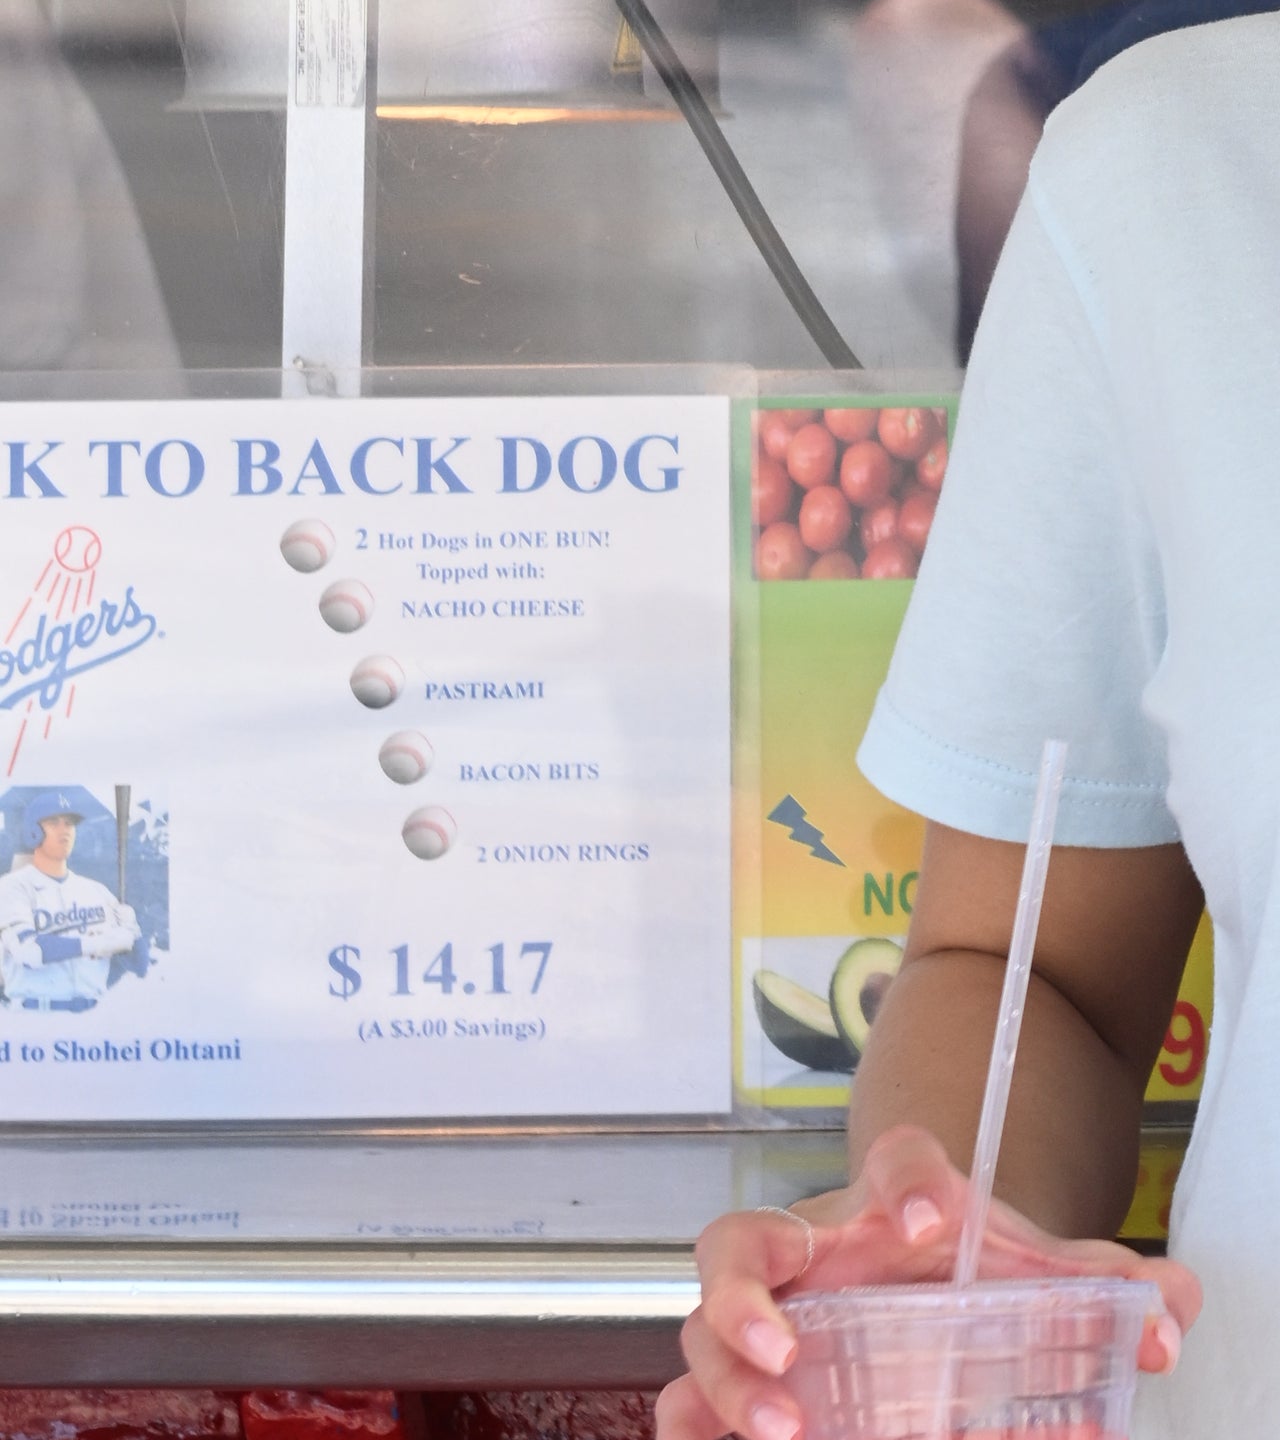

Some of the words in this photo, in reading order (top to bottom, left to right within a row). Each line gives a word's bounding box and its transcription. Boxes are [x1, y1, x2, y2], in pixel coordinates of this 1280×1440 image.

[88, 439, 207, 498] TO
[233, 436, 473, 497] BACK
[499, 434, 684, 494] DOG
[355, 527, 370, 551] 2
[378, 532, 415, 550] Hot
[421, 532, 470, 553] Dogs
[474, 532, 494, 549] in
[499, 531, 549, 549] ONE
[555, 530, 611, 549] BUN!
[418, 562, 490, 585] Topped
[495, 561, 546, 580] with:
[402, 600, 488, 618] NACHO
[491, 599, 585, 618] CHEESE
[425, 681, 545, 701] PASTRAMI
[459, 763, 542, 782] BACON
[548, 763, 601, 781] BITS
[476, 845, 493, 864] 2
[493, 844, 571, 862] ONION
[578, 842, 652, 862] RINGS
[327, 943, 364, 1001] $
[391, 941, 555, 996] 14.17
[357, 1020, 386, 1045] (A
[390, 1019, 449, 1040] $3.00
[453, 1018, 548, 1043] Savings)
[20, 1044, 47, 1063] to
[53, 1039, 143, 1062] Shohei
[149, 1038, 243, 1062] Ohtani
